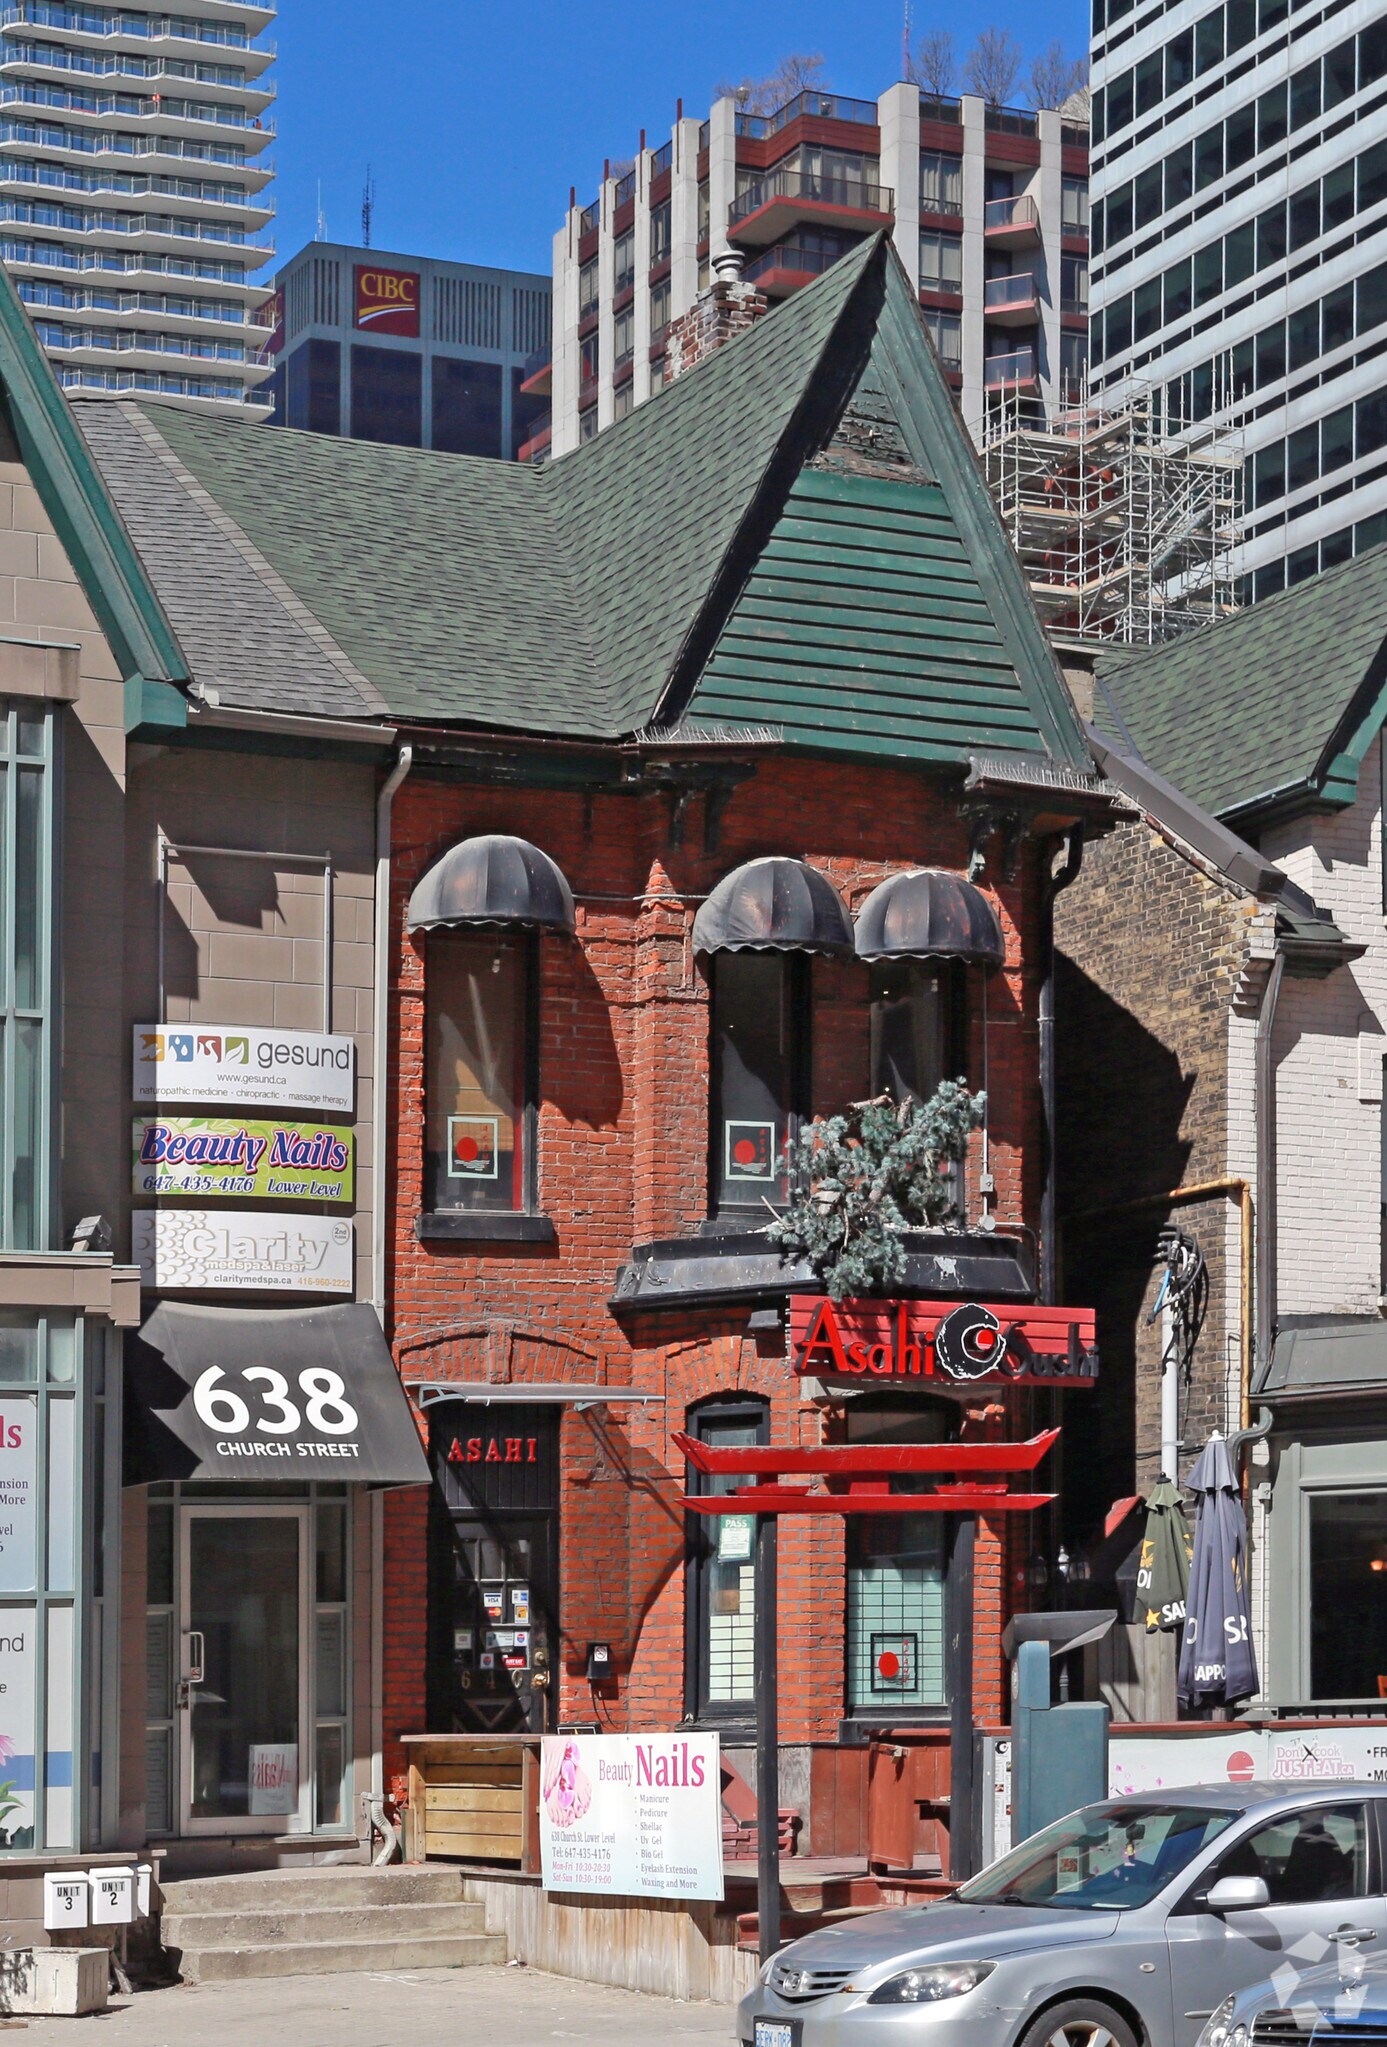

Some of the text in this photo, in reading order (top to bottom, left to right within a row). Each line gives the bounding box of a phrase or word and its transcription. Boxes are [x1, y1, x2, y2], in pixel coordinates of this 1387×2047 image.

[360, 272, 414, 302] CIBC
[256, 1042, 350, 1070] gesund
[216, 1073, 287, 1085] www.gesund.ca
[140, 1086, 348, 1106] naturopathic medicine chiropractic massage therapy
[140, 1124, 348, 1174] Beauty Nails
[143, 1175, 342, 1197] 647-435-4176 Lower Level
[182, 1228, 329, 1270] Clarity
[205, 1259, 306, 1272] medspa&laser
[214, 1274, 350, 1288] claritymedspa.ca 416-960-2222
[796, 1300, 1100, 1378] Asahi Sushi
[192, 1364, 359, 1436] 638
[216, 1442, 359, 1457] CHURCH STREET
[448, 1438, 537, 1462] ASAHI
[725, 1519, 748, 1528] PASS
[1314, 1745, 1340, 1757] cook
[599, 1742, 705, 1787] Beauty Nails
[640, 1794, 670, 1803] Manicure
[640, 1808, 668, 1817] Pedicure
[640, 1822, 662, 1831] Shellac
[584, 1832, 600, 1843] Lower
[602, 1832, 616, 1843] Level
[652, 1836, 662, 1845] Gel
[564, 1847, 611, 1860] 647-435-4176
[653, 1850, 663, 1859] Gel
[552, 1861, 610, 1872] Mon-Fri 10:30-20:30
[641, 1864, 698, 1875] Eyelash Extension
[102, 1882, 125, 1892] UNIT
[642, 1877, 697, 1889] Waxing and More
[57, 1886, 80, 1897] UNIT
[65, 1897, 73, 1910] 3
[110, 1892, 118, 1905] 2
